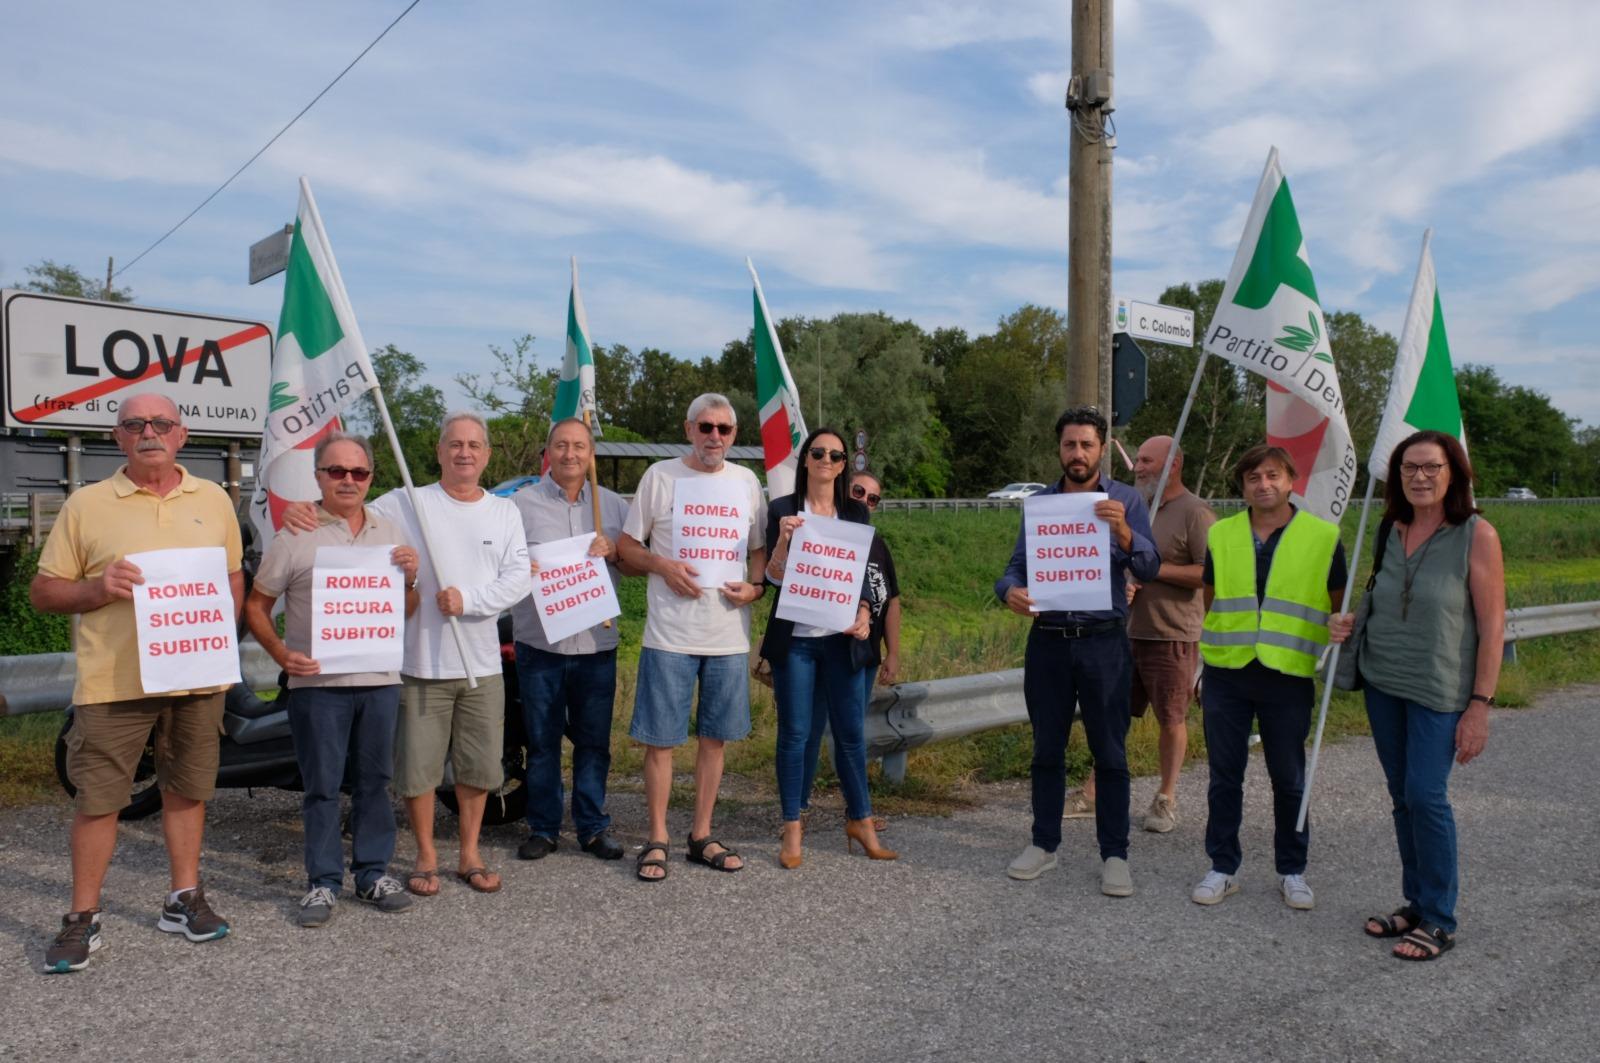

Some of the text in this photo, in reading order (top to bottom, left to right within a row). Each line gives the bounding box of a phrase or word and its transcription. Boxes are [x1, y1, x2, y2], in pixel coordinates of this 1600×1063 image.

[1140, 317, 1191, 338] C. Colombo
[65, 324, 232, 387] LOVA
[1209, 325, 1289, 372] Partito
[86, 400, 100, 412] di
[207, 406, 257, 422] LUPIA)
[684, 504, 740, 518] ROMEA
[681, 526, 740, 540] SICURA
[1037, 522, 1097, 536] ROMEA
[679, 548, 740, 561] SUBITO!
[801, 541, 856, 561] ROMEA
[1036, 545, 1099, 559] SICURA
[326, 575, 391, 589] ROMEA
[795, 562, 854, 583] SICURA
[1035, 569, 1102, 582] SUBITO!
[148, 582, 218, 599] ROMEA
[541, 569, 599, 596] SICURA
[544, 585, 606, 616] SUBITO!
[788, 583, 852, 605] SUBITO!
[323, 601, 393, 615] SICURA
[149, 609, 224, 628] SICURA
[320, 626, 395, 641] SUBITO!
[148, 636, 229, 657] SUBITO!
